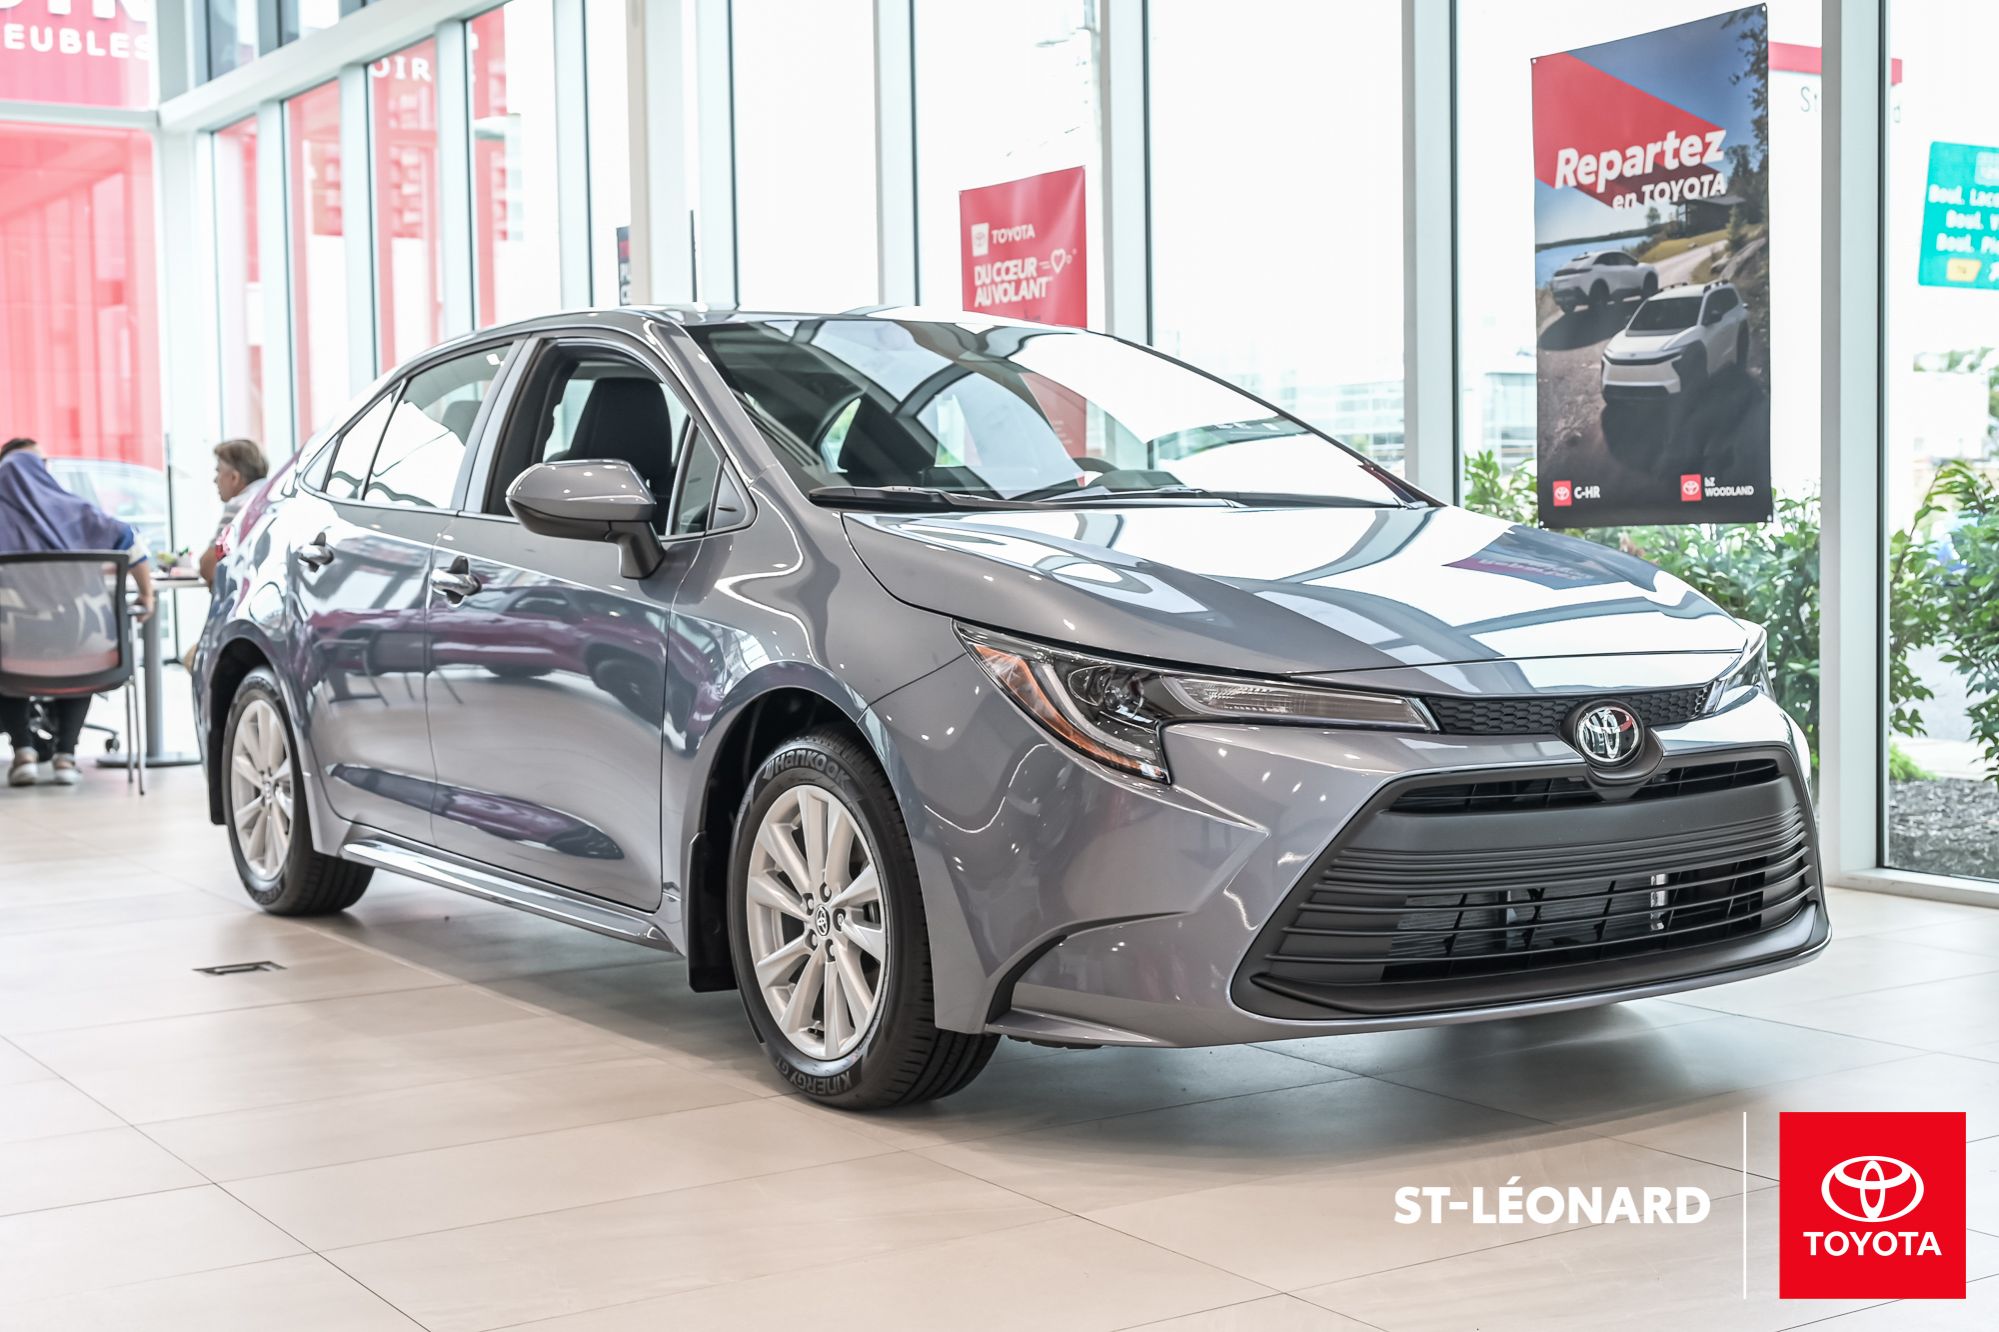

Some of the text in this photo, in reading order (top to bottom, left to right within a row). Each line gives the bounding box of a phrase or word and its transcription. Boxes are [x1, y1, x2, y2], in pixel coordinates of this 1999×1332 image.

[4, 23, 150, 60] EUBLES
[1555, 130, 1727, 193] Repartez
[1612, 172, 1727, 209] en TOYOTA
[991, 223, 1036, 244] TOYOTA
[974, 257, 1038, 287] DU CŒUR
[974, 277, 1048, 308] AU VOLANT
[1574, 485, 1600, 499] C-HR
[1704, 485, 1755, 498] WOODLAND
